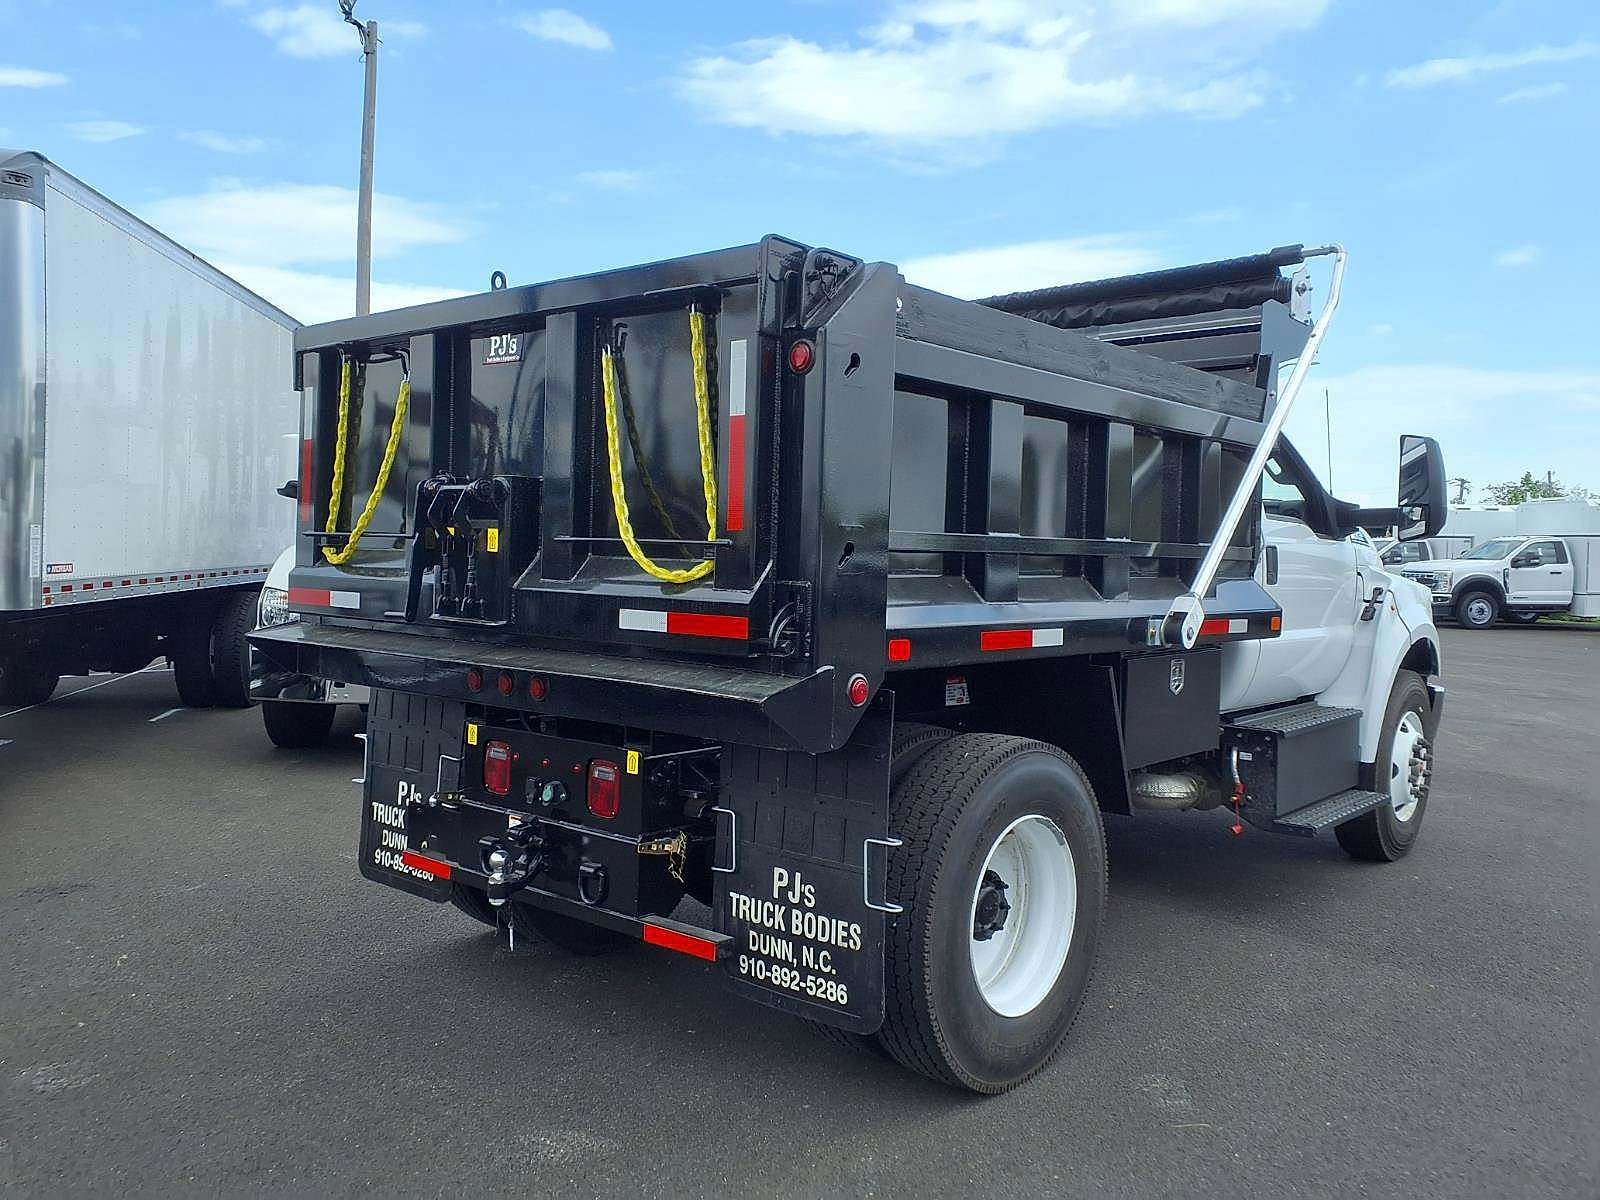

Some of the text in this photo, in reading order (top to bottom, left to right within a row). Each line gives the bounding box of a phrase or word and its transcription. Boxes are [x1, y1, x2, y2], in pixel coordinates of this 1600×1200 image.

[489, 333, 517, 357] PJ's
[371, 801, 406, 830] TRUCK
[381, 829, 408, 851] DUNN
[729, 891, 862, 951] TRUCK BODIES
[749, 930, 837, 975] DUNN, N.C.
[739, 954, 848, 1005] 910-892-5286
